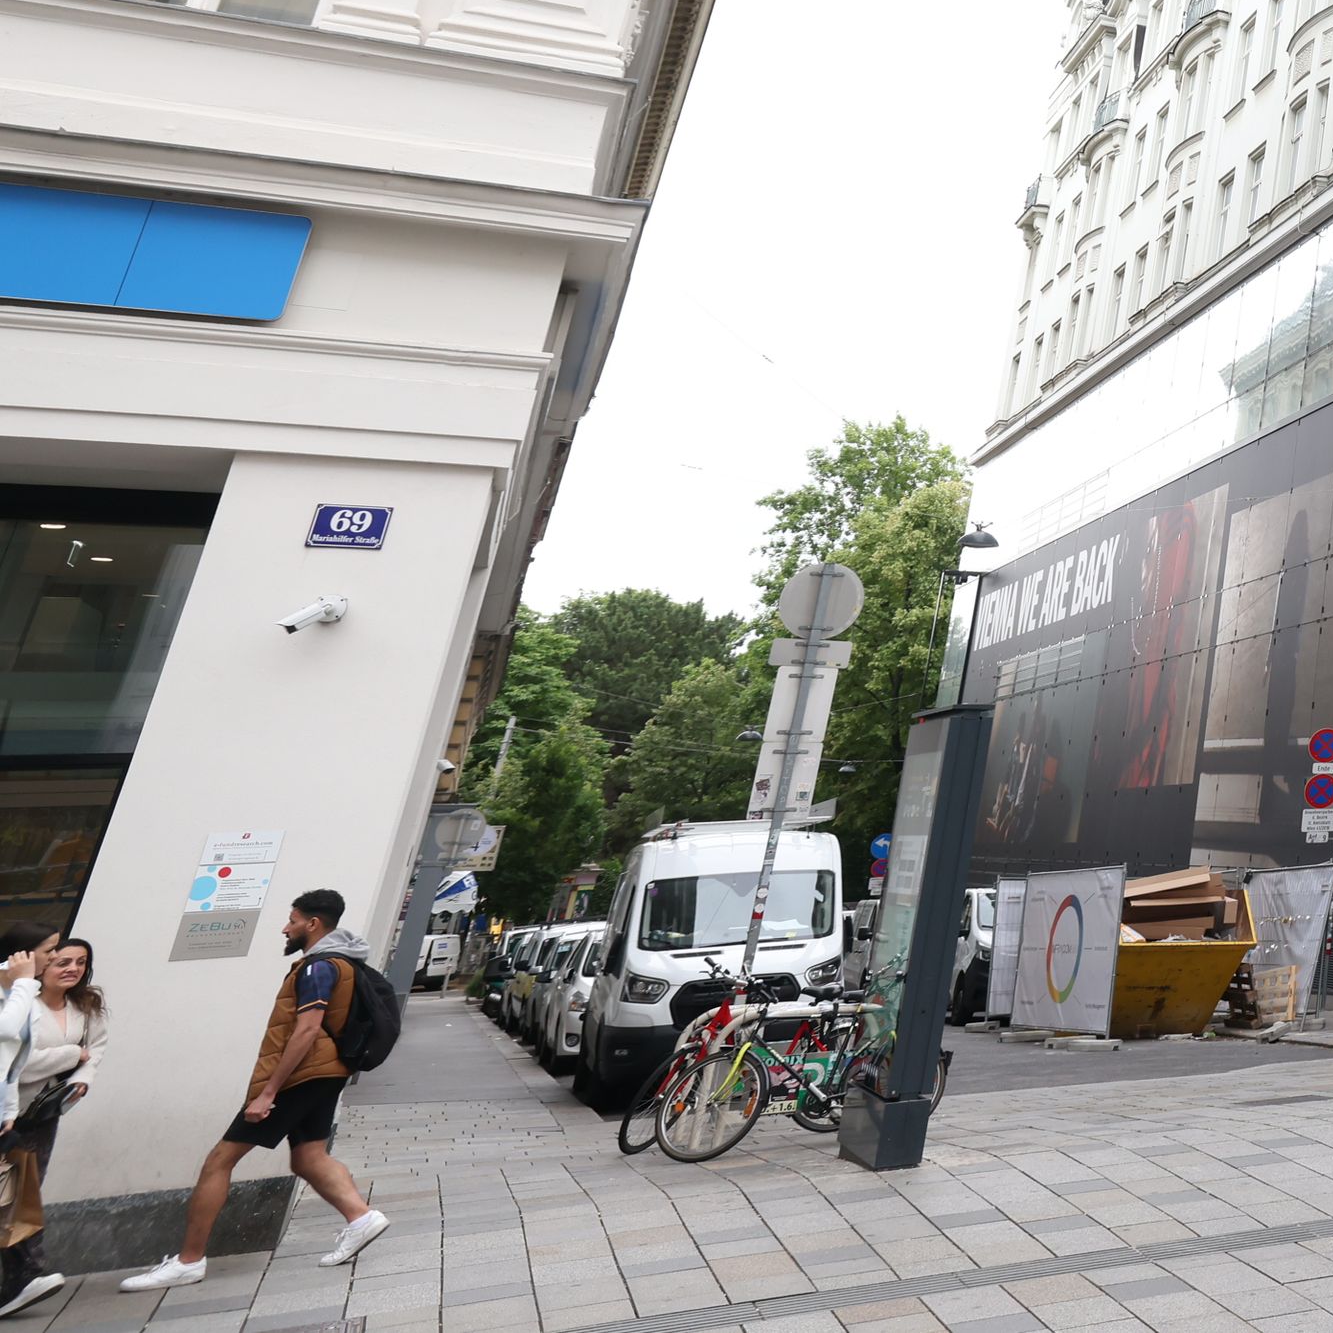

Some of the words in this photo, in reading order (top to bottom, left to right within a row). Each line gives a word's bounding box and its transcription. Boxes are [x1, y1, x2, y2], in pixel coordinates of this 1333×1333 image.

[330, 510, 373, 533] 69
[312, 534, 354, 543] Mariahilfer
[354, 536, 379, 544] Straße
[973, 581, 1019, 651] VIENNA
[1016, 569, 1044, 636] WE
[1038, 555, 1075, 628] ARE
[1070, 534, 1120, 616] BACK
